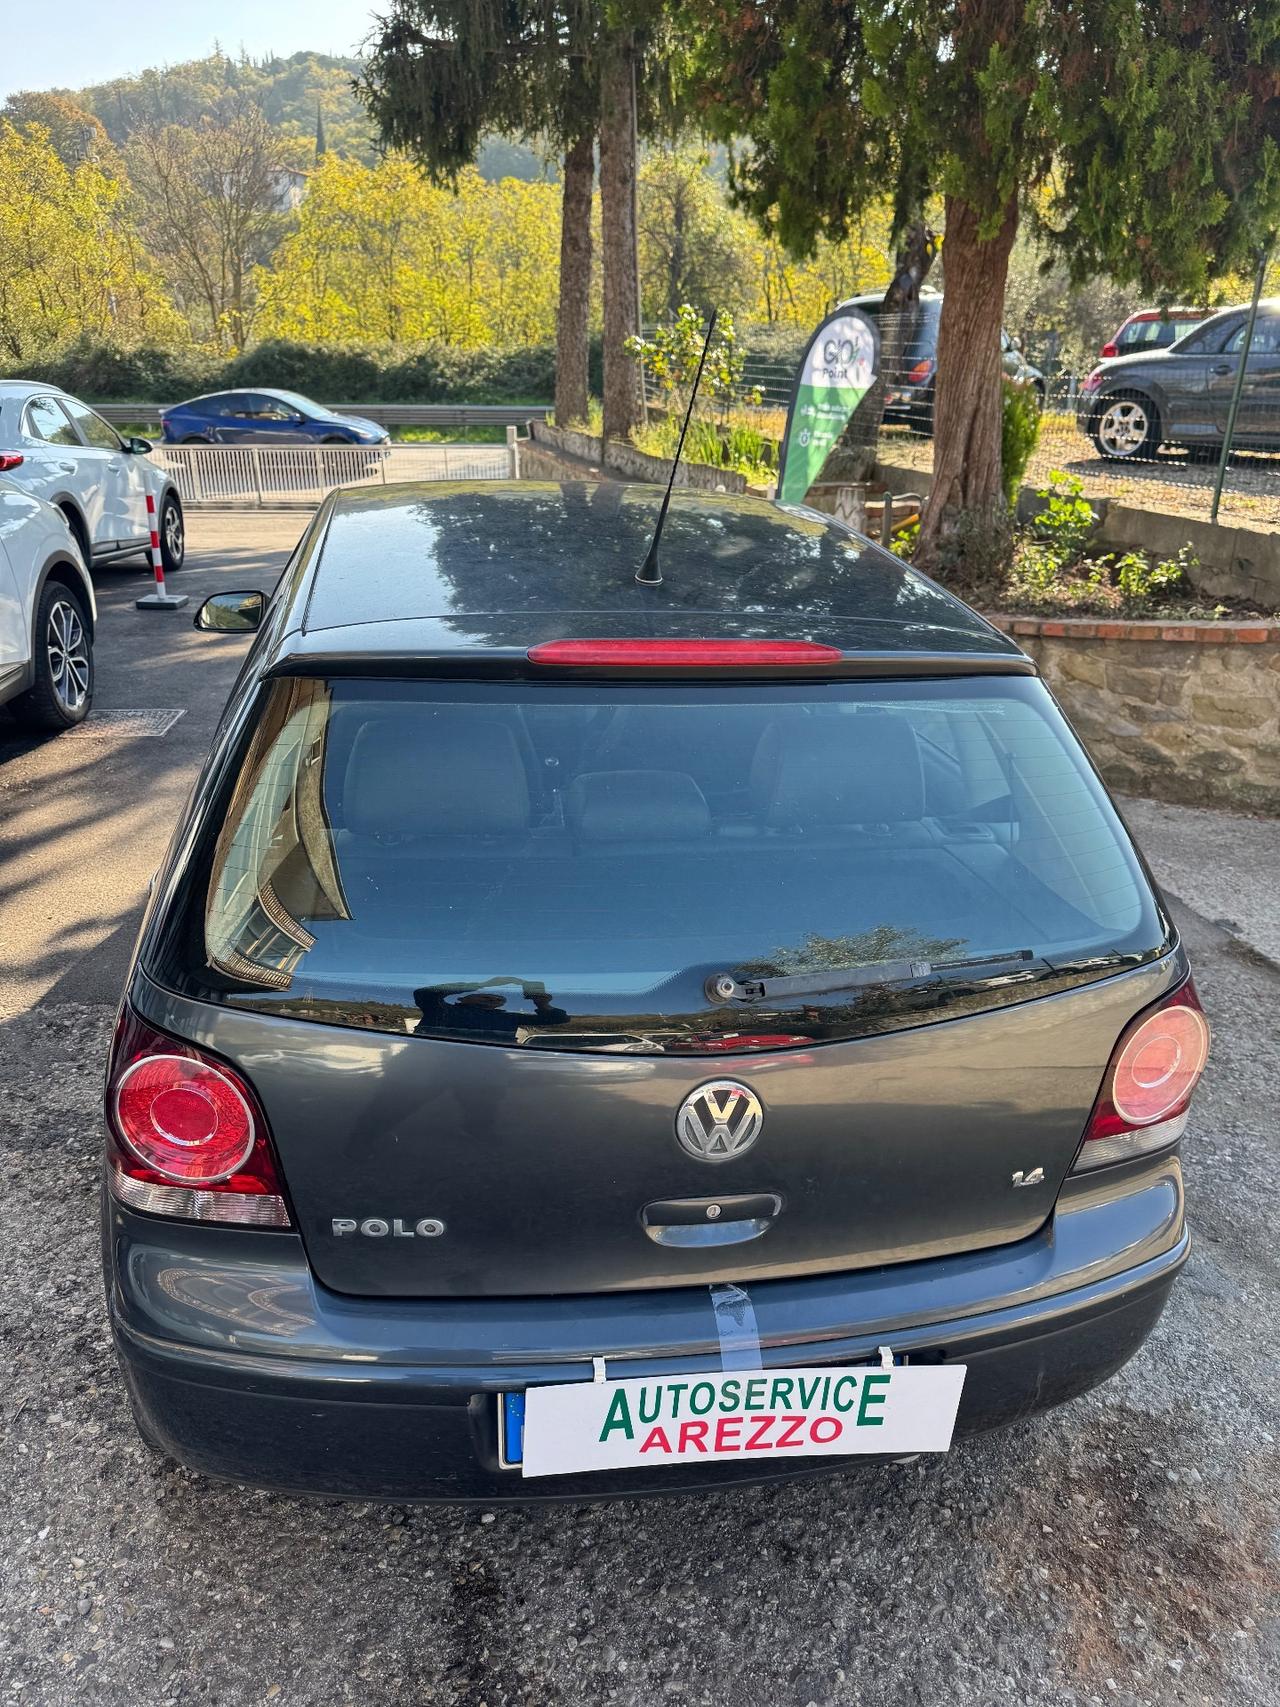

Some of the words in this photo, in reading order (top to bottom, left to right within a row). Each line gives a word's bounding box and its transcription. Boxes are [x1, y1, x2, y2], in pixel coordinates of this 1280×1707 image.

[823, 367, 849, 379] Point
[678, 1082, 763, 1160] VW
[331, 1218, 445, 1238] POLO
[599, 1374, 891, 1442] AUTOSERVICE
[639, 1416, 843, 1453] AREZZO
